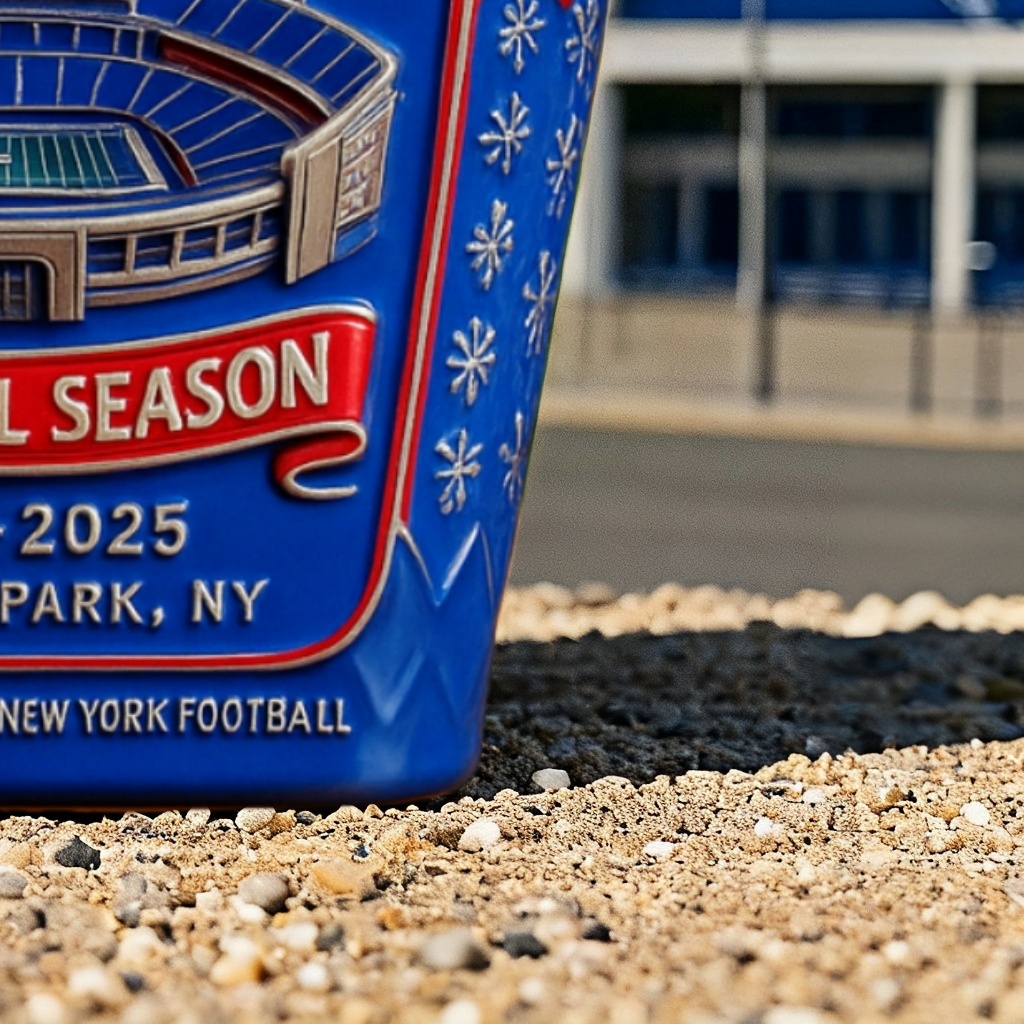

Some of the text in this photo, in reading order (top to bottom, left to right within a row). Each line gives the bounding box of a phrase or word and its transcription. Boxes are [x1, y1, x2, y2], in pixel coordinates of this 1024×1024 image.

[51, 330, 331, 441] SEASON
[0, 580, 165, 627] PARK,
[192, 578, 270, 623] NY
[79, 696, 169, 732] YORK
[178, 696, 352, 733] FOOTBALL
